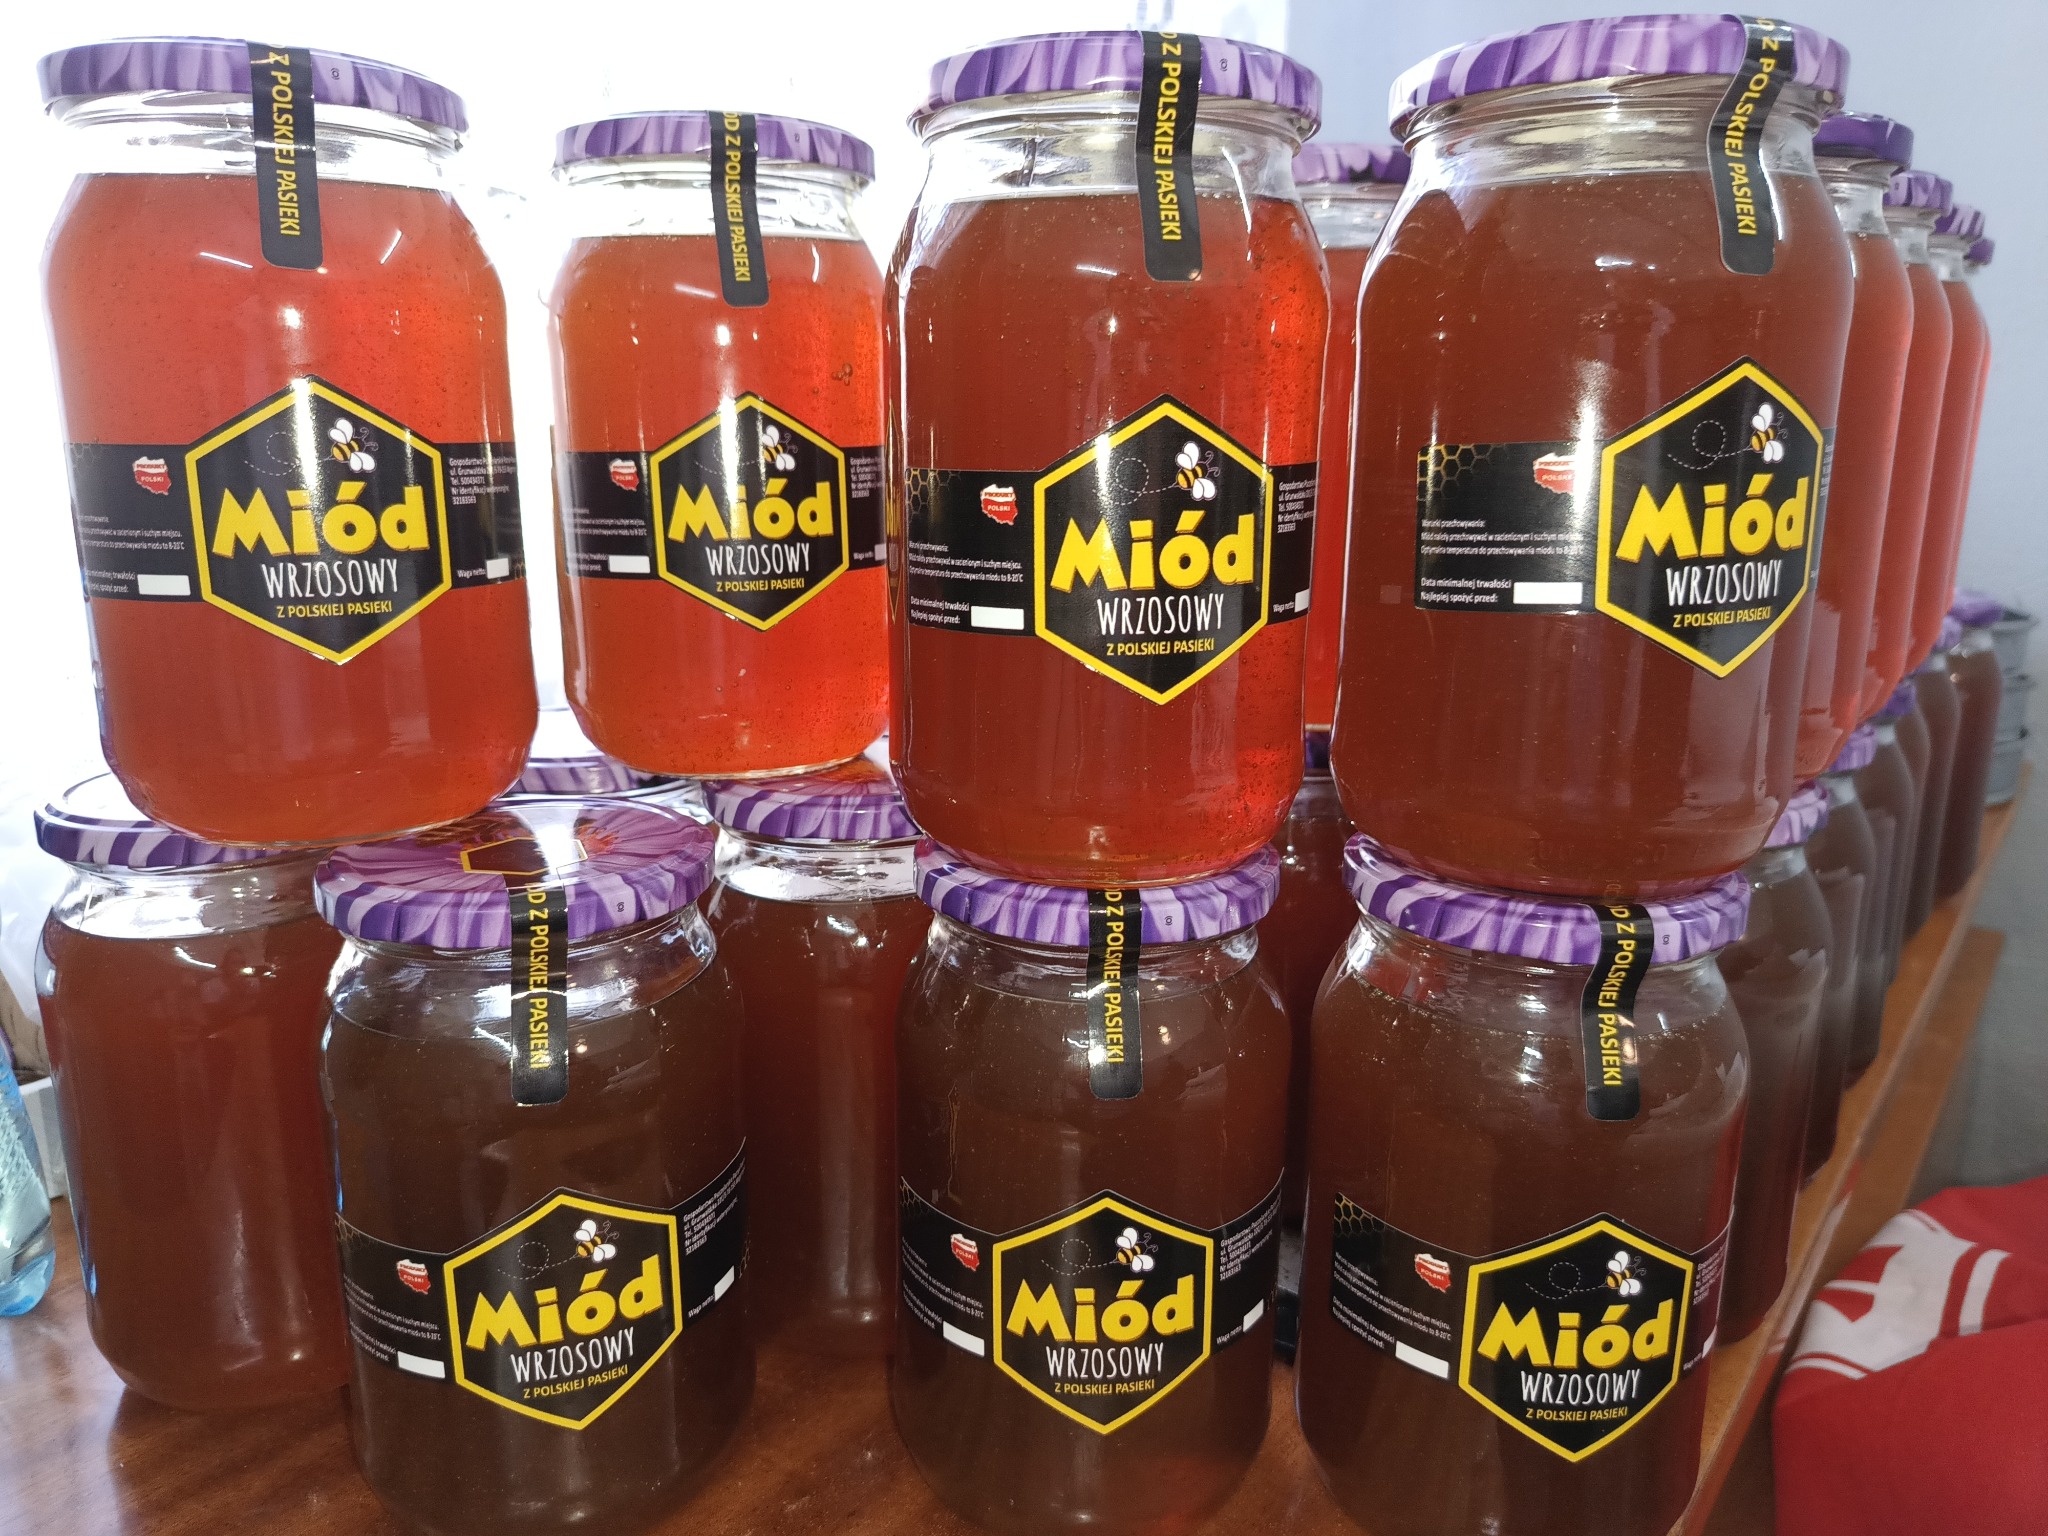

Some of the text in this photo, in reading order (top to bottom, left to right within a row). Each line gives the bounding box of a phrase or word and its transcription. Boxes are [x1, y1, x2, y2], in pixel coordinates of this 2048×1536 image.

[1162, 43, 1182, 55] Z
[1762, 36, 1780, 50] Z
[1153, 62, 1181, 165] POLSKIEJ
[1724, 57, 1776, 157] POLSKIEJ
[268, 51, 300, 235] Z POLSKIEJ PASIEKI
[725, 136, 751, 281] Z POLSKIEJ PASIEKI
[1155, 170, 1182, 240] PASIEKI
[1728, 162, 1757, 235] PASIEKI
[140, 475, 166, 483] POLSKI
[212, 480, 431, 559] Miód
[668, 478, 834, 543] Miód
[987, 504, 1011, 512] POLSKI
[1615, 473, 1810, 563] Miód
[1534, 531, 1556, 542] suchym
[705, 543, 810, 577] WRZOSOWY
[1050, 510, 1255, 592] Miód
[261, 557, 399, 599] WRZOSOWY
[716, 578, 805, 592] Z POLSKIEJ PASIEKI
[1421, 577, 1511, 590] Data minimalnej trwałości
[1665, 558, 1782, 607] WRZOSOWY
[276, 600, 393, 619] Z POLSKIEJ PASIEKI
[1421, 591, 1498, 604] Najlepiej spożyć przed:
[1097, 592, 1225, 636] WRZOSOWY
[1672, 605, 1771, 628] Z POLSKIEJ PASIEKI
[1106, 638, 1215, 656] Z POLSKIEJ PASIEKI
[528, 909, 548, 921] Z
[1103, 905, 1125, 1063] Z POLSKIEJ PASIEKI
[1598, 923, 1636, 1085] Z POLSKIEJ PASIEKI
[528, 998, 550, 1069] PASIEKI
[684, 1228, 693, 1238] Tel.
[956, 1249, 973, 1259] POLSKI
[1220, 1255, 1228, 1263] Tel.
[404, 1275, 424, 1283] POLSKI
[1421, 1268, 1443, 1280] POLSKI
[466, 1254, 665, 1351] Miód
[688, 1304, 701, 1318] Waga
[1006, 1273, 1196, 1343] Miód
[1370, 1323, 1395, 1343] trwałości
[1431, 1316, 1451, 1330] miejscu.
[1477, 1298, 1674, 1369] Miód
[1216, 1332, 1230, 1344] Waga
[1368, 1334, 1384, 1349] przed:
[510, 1326, 635, 1384] WRZOSOWY
[1046, 1341, 1164, 1380] WRZOSOWY
[523, 1364, 629, 1399] Z POLSKIEJ PASIEKI
[1054, 1378, 1155, 1394] Z POLSKIEJ PASIEKI
[1520, 1369, 1641, 1407] WRZOSOWY
[1526, 1407, 1628, 1421] Z POLSKIEJ PASIEKI
